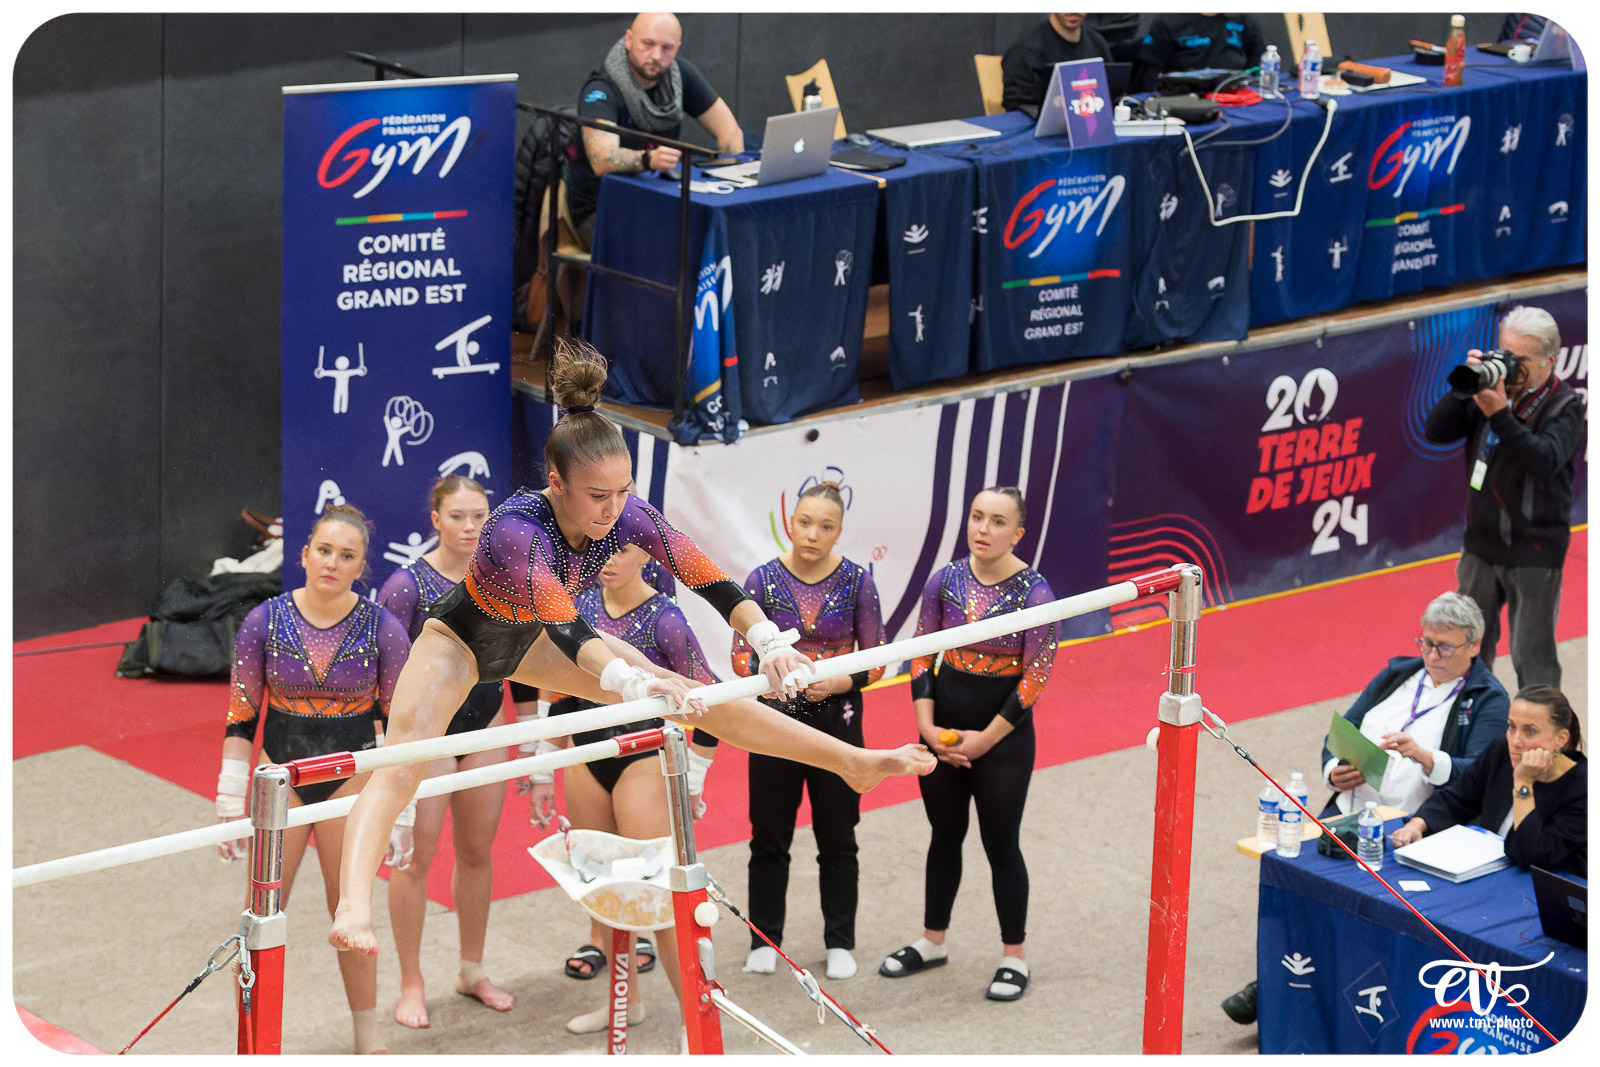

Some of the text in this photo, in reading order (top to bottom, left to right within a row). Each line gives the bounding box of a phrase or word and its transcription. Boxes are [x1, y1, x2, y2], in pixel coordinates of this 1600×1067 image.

[382, 113, 447, 126] FÉDÉRATION
[382, 124, 441, 137] FRANÇAISE
[357, 225, 447, 256] COMITÉ
[342, 257, 462, 284] RÉGIONAL
[336, 283, 468, 311] GRAND EST
[1038, 283, 1080, 303] COMITÉ
[1029, 304, 1084, 322] RÉGIONAL
[1023, 322, 1085, 341] GRAND EST
[1260, 367, 1339, 432] 20
[1258, 416, 1364, 473] TERRE
[1246, 452, 1377, 515] DE JEUX
[1310, 495, 1369, 556] 24
